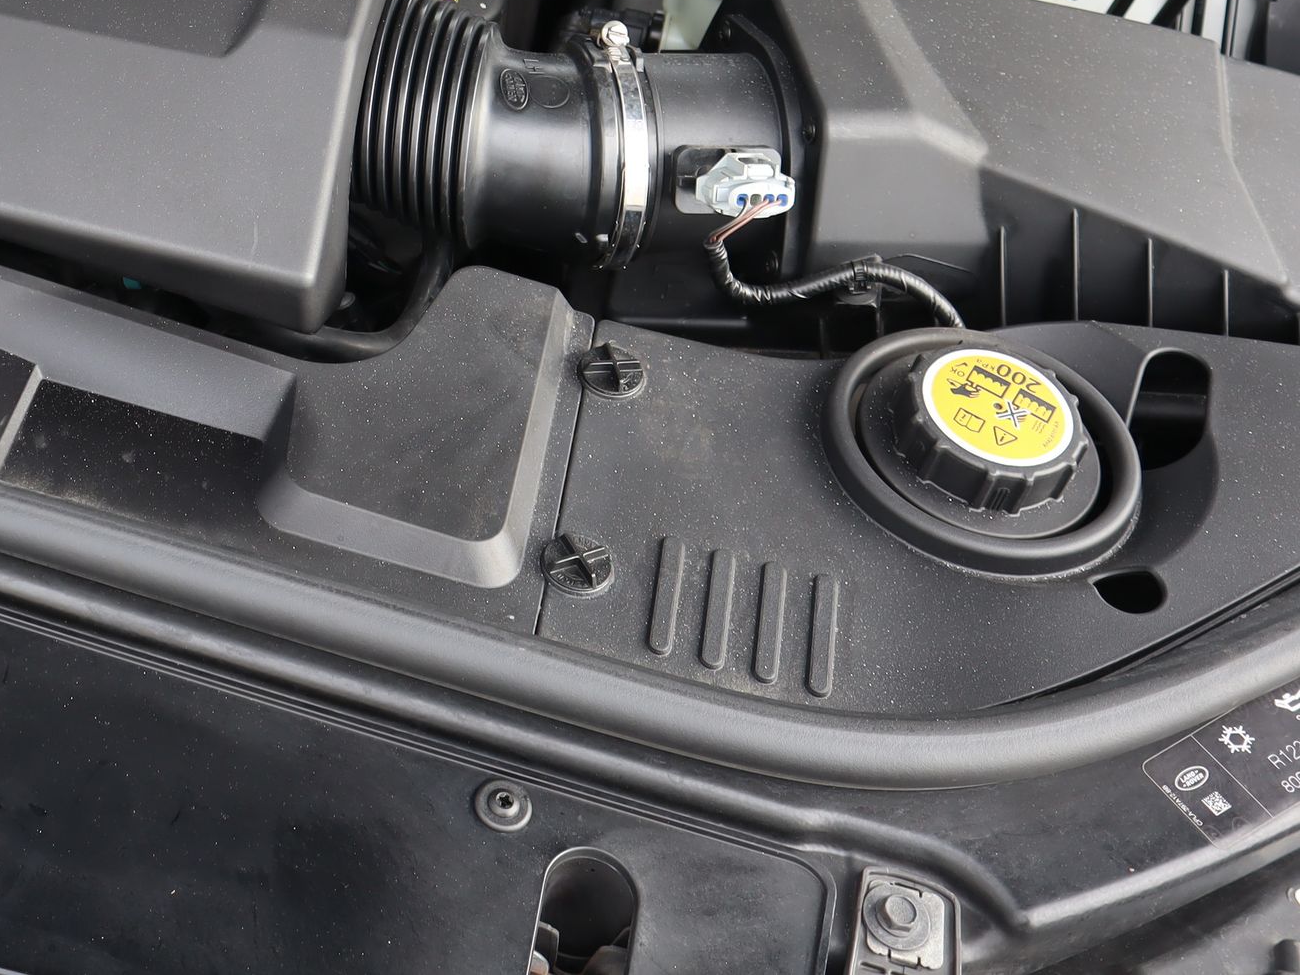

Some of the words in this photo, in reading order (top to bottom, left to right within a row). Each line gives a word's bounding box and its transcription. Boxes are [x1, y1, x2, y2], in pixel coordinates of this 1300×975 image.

[950, 366, 965, 377] OK
[996, 363, 1042, 393] 200
[1180, 770, 1196, 783] LAND
[1185, 773, 1204, 787] ROVER
